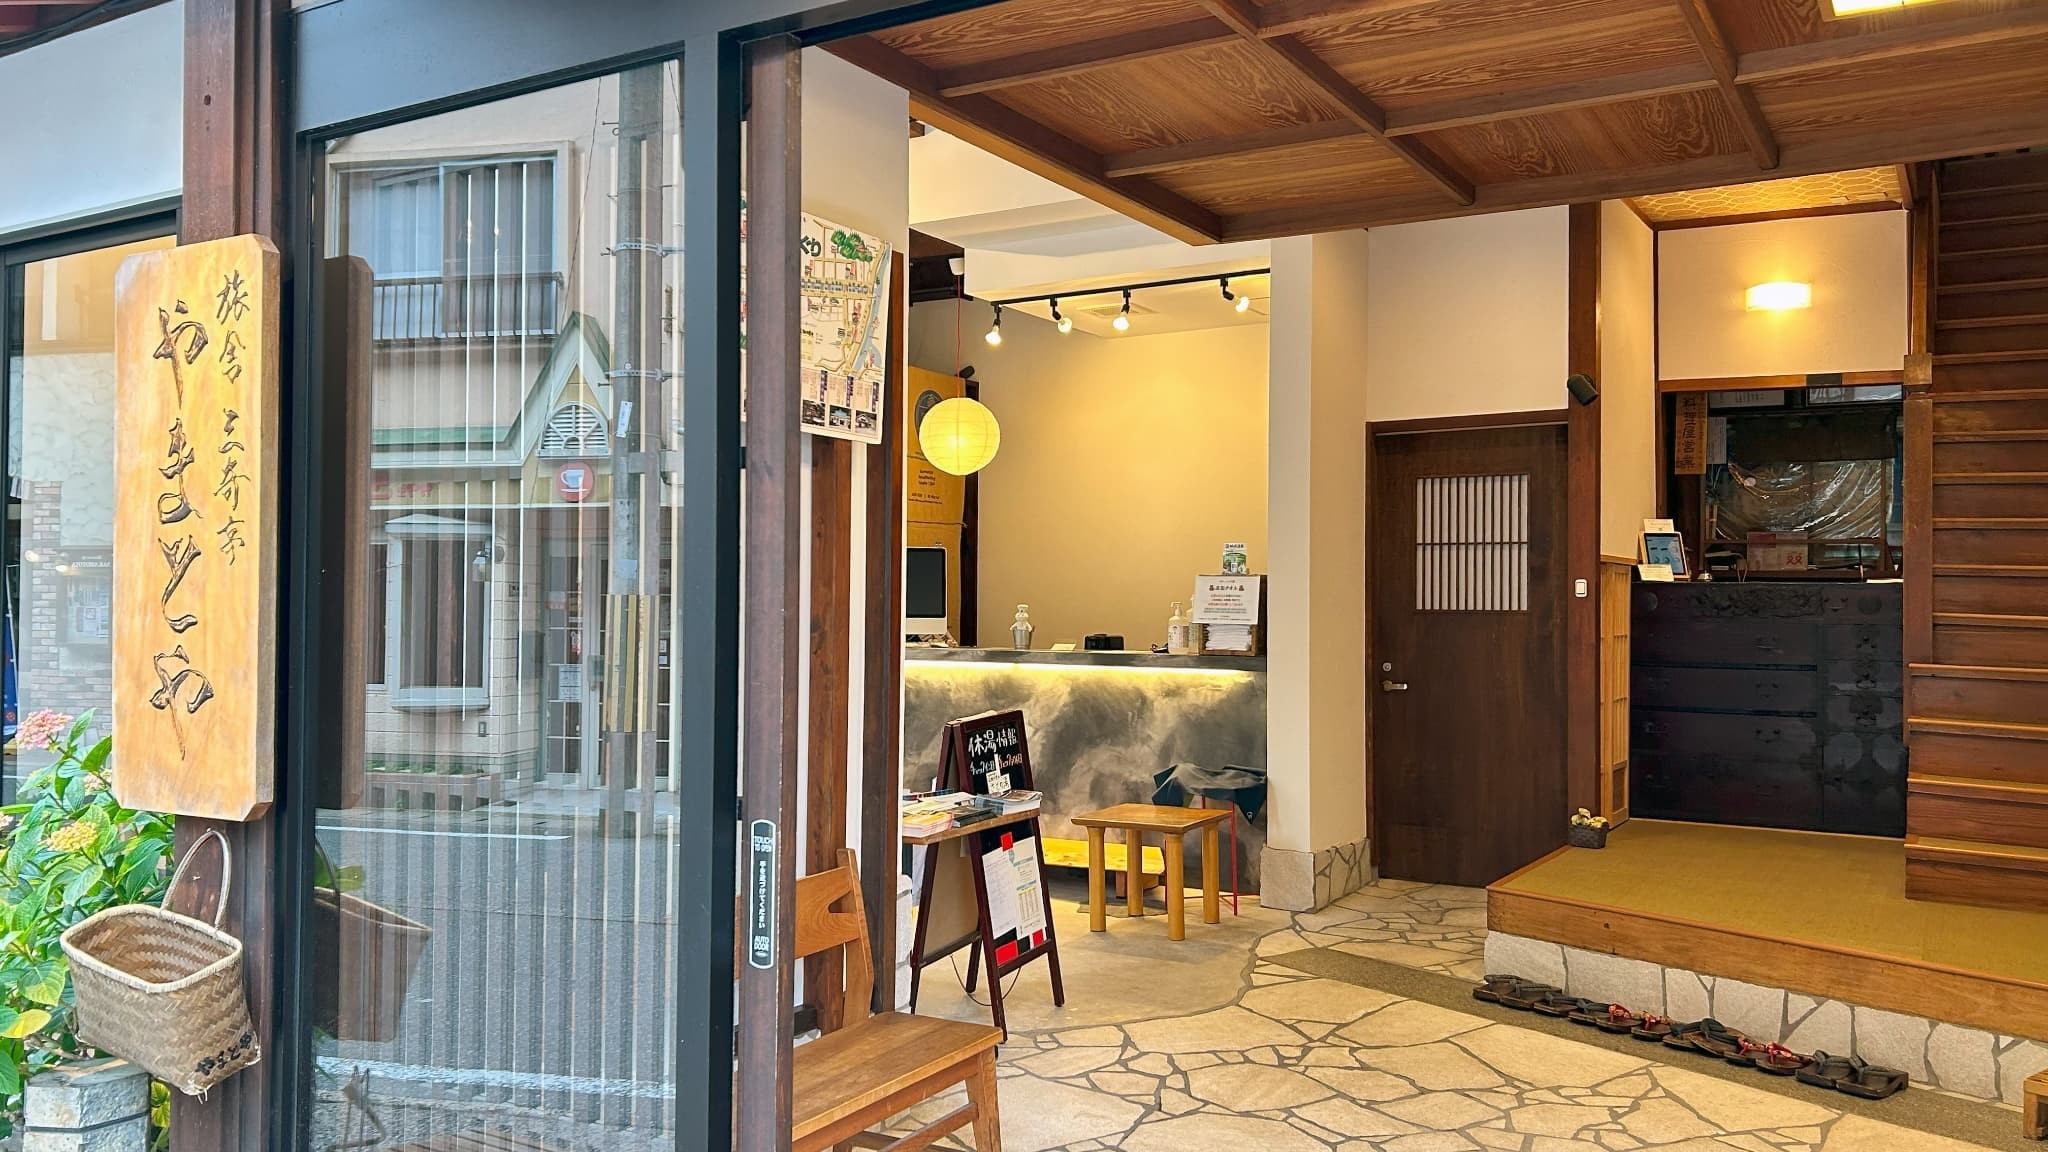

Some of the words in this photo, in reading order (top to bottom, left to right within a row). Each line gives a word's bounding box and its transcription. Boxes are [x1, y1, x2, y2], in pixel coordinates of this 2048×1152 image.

[149, 299, 214, 761] やまとや
[968, 728, 1018, 758] 休湯情報
[754, 836, 772, 844] TOUCH
[761, 844, 772, 852] OPEN
[754, 935, 770, 944] AUTO
[753, 943, 769, 951] DOOR
